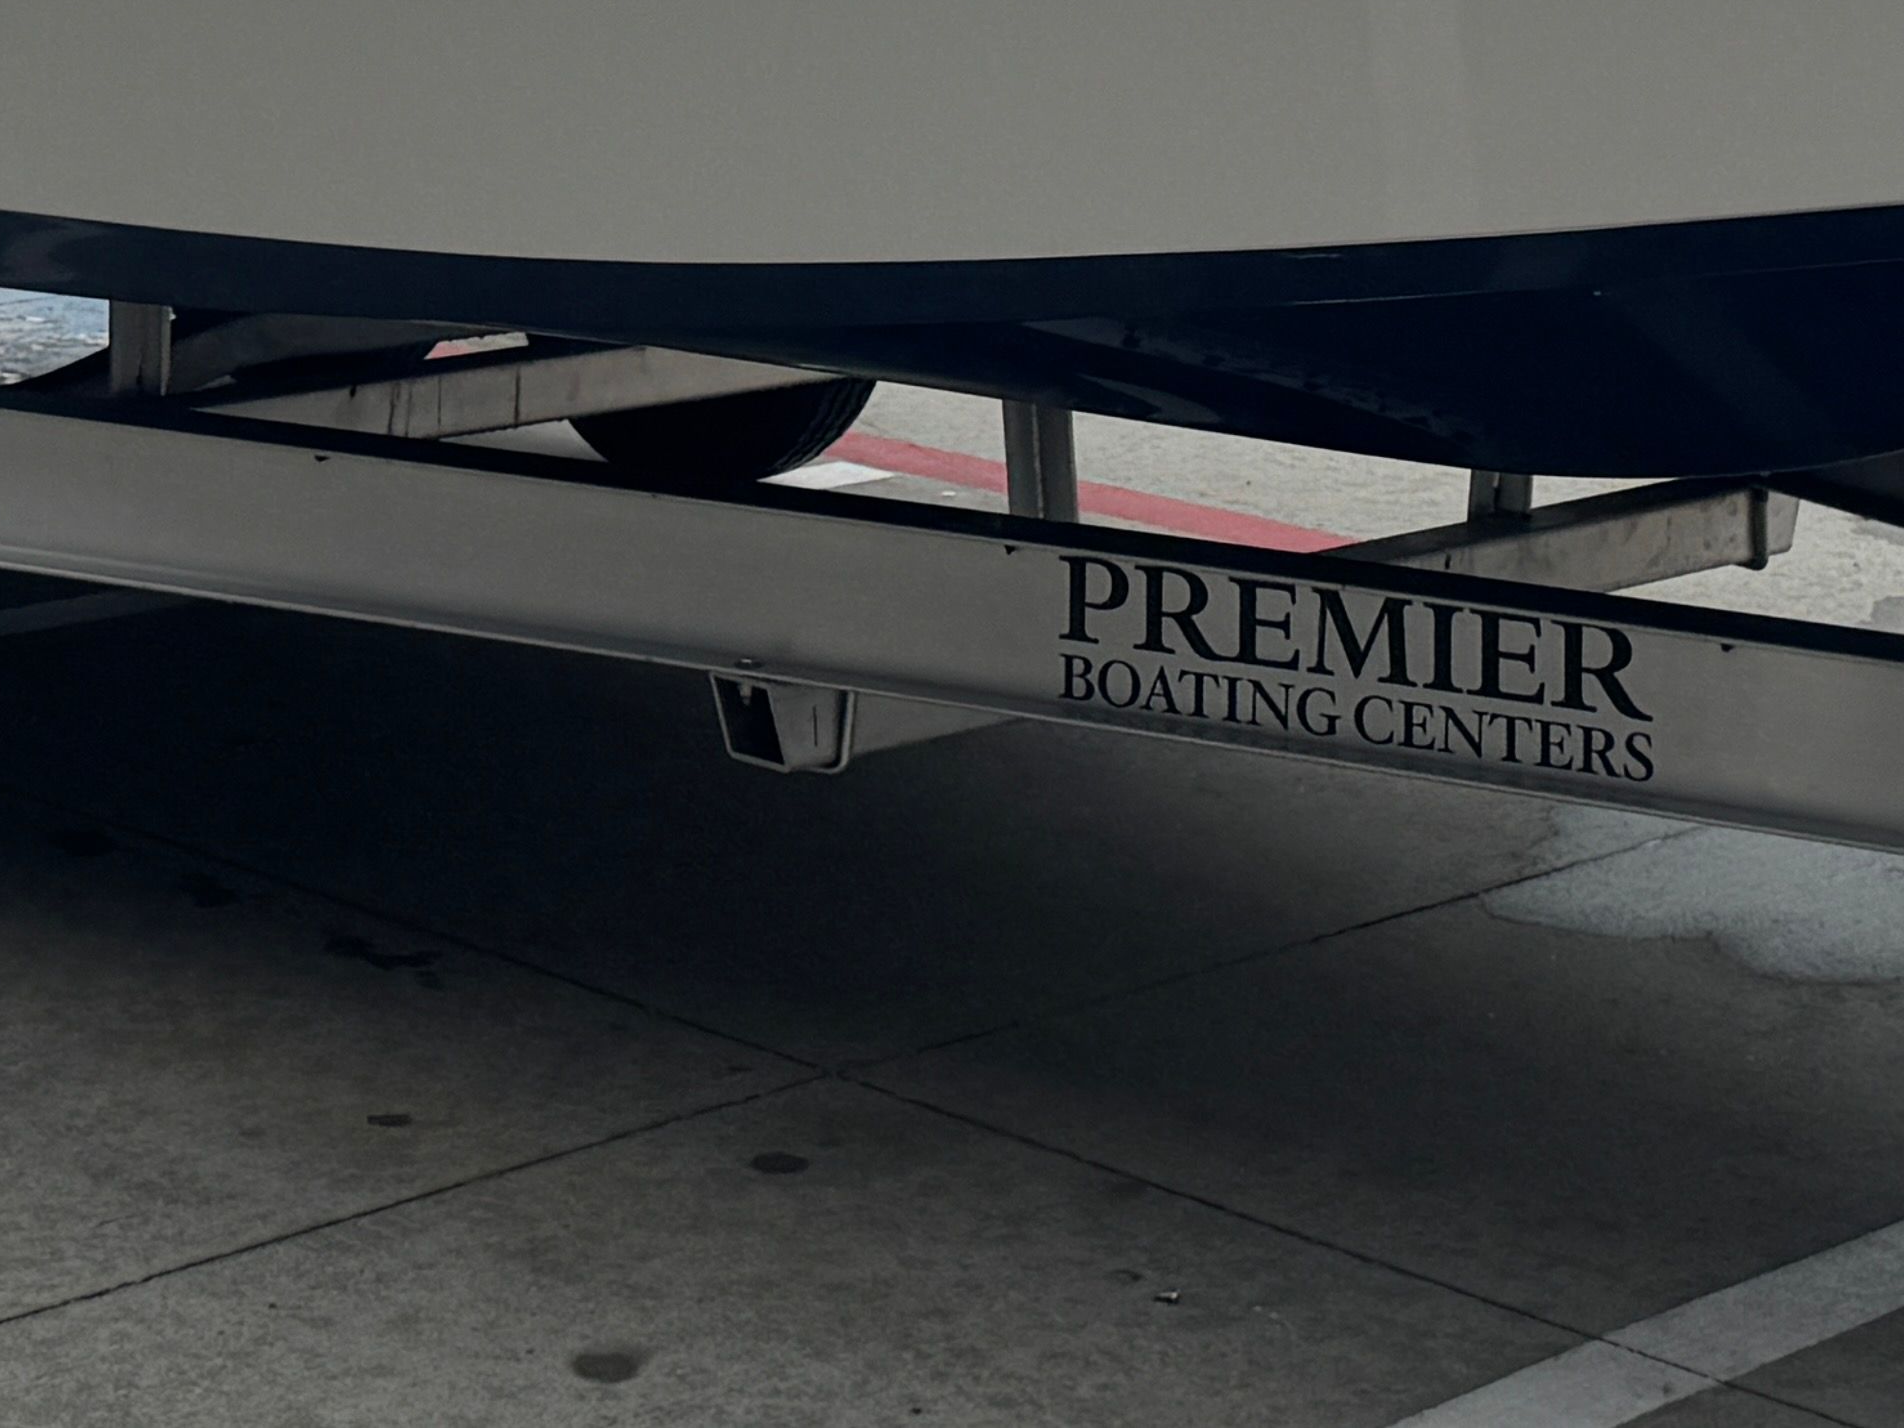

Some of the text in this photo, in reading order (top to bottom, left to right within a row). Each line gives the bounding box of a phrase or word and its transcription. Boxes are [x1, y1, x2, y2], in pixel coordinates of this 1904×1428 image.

[1057, 554, 1654, 722] PREMIER
[1057, 652, 1655, 783] BOATING CENTERS
